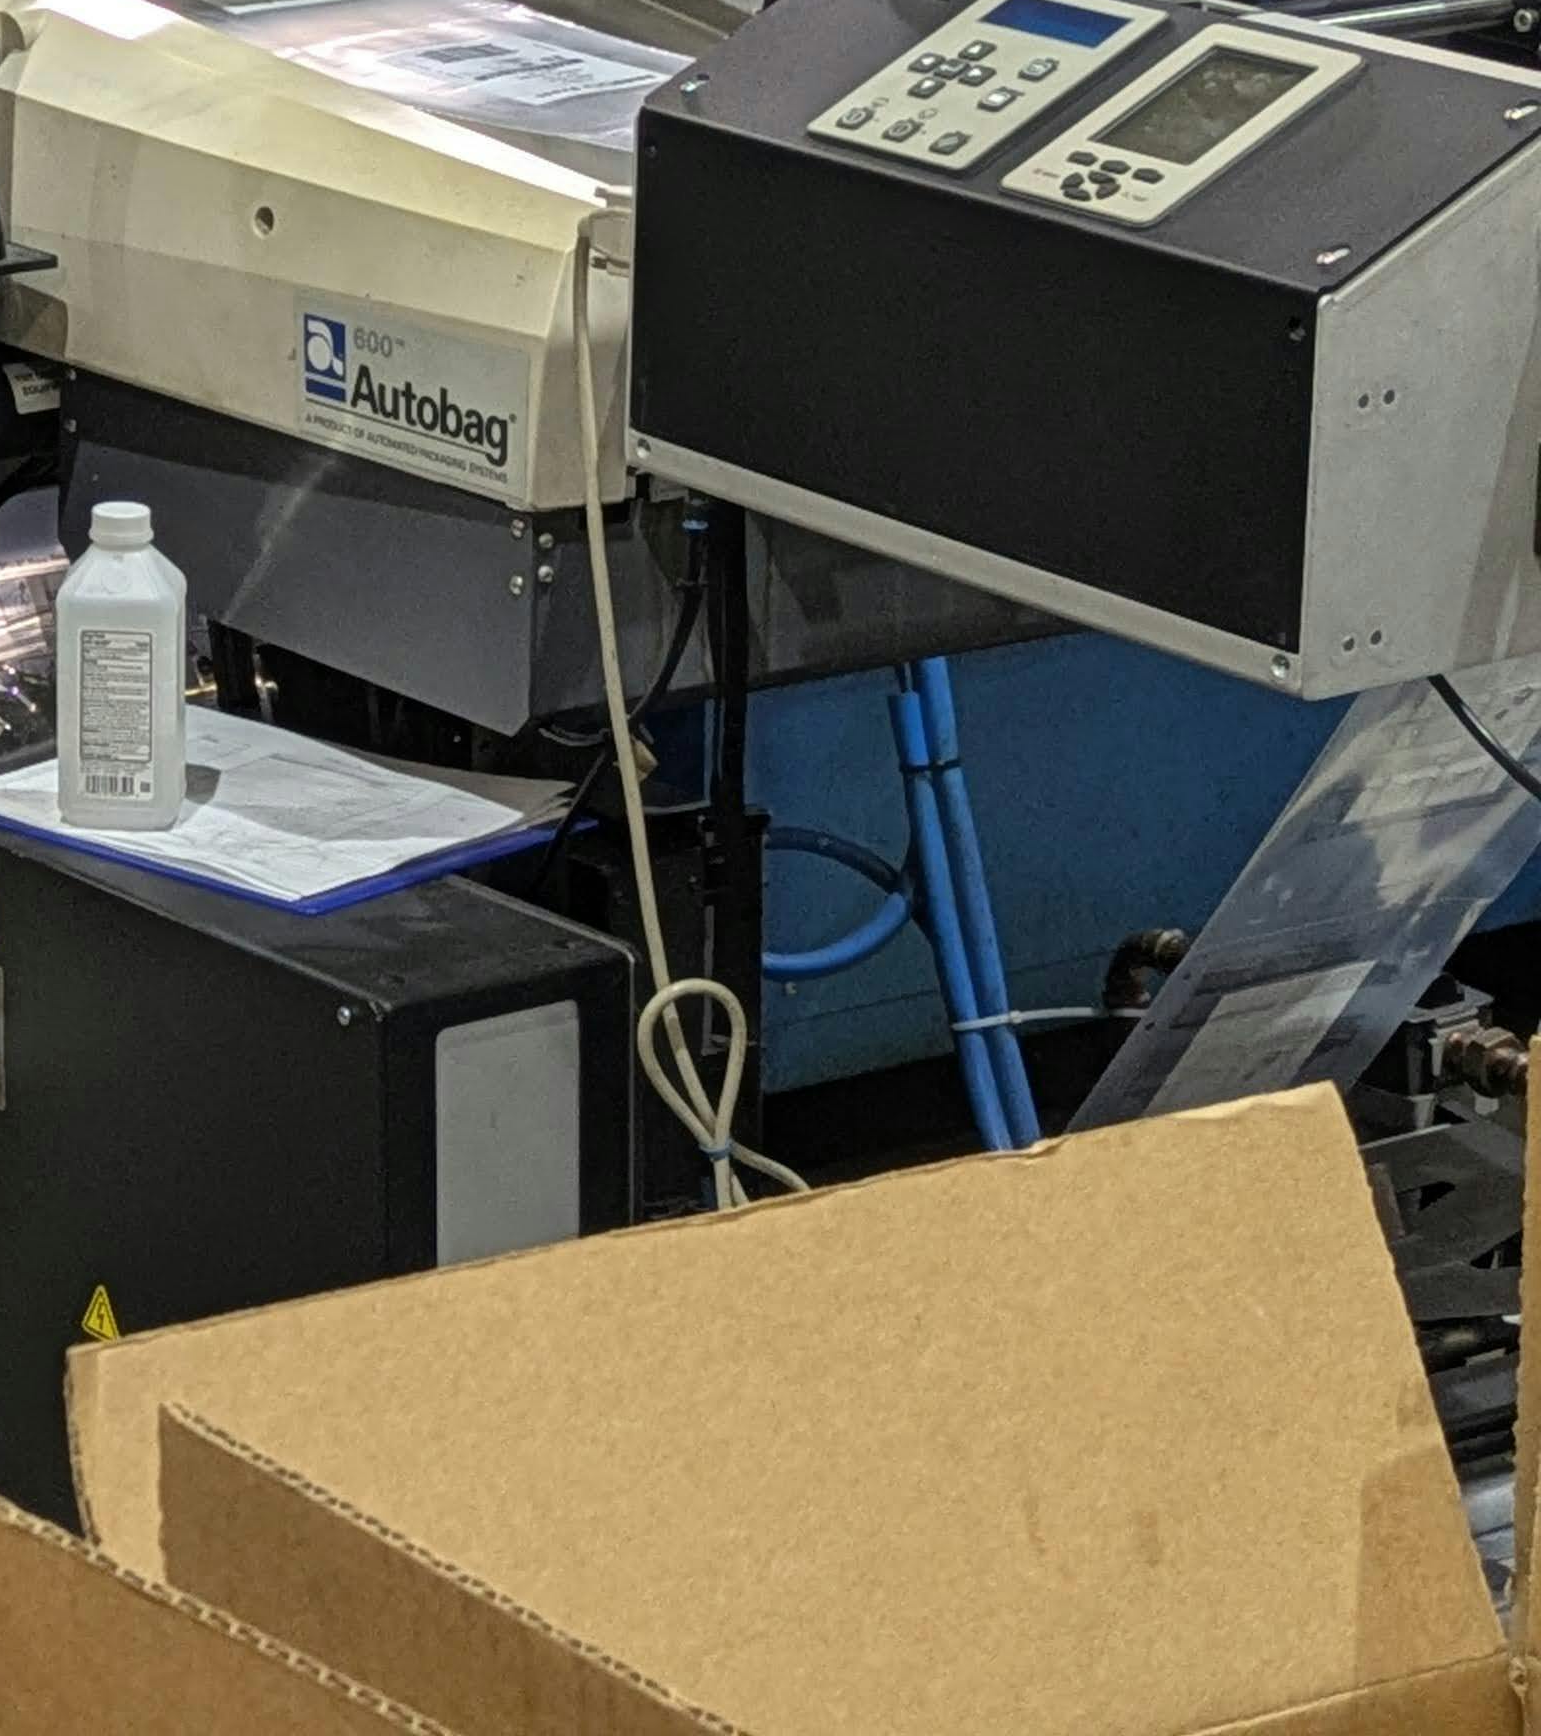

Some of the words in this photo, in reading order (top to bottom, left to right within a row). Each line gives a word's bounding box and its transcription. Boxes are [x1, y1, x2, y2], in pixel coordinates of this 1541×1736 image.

[314, 416, 352, 435] PRODUCT
[366, 431, 416, 456] AUTOMATED
[468, 461, 509, 485] SYSTEMS
